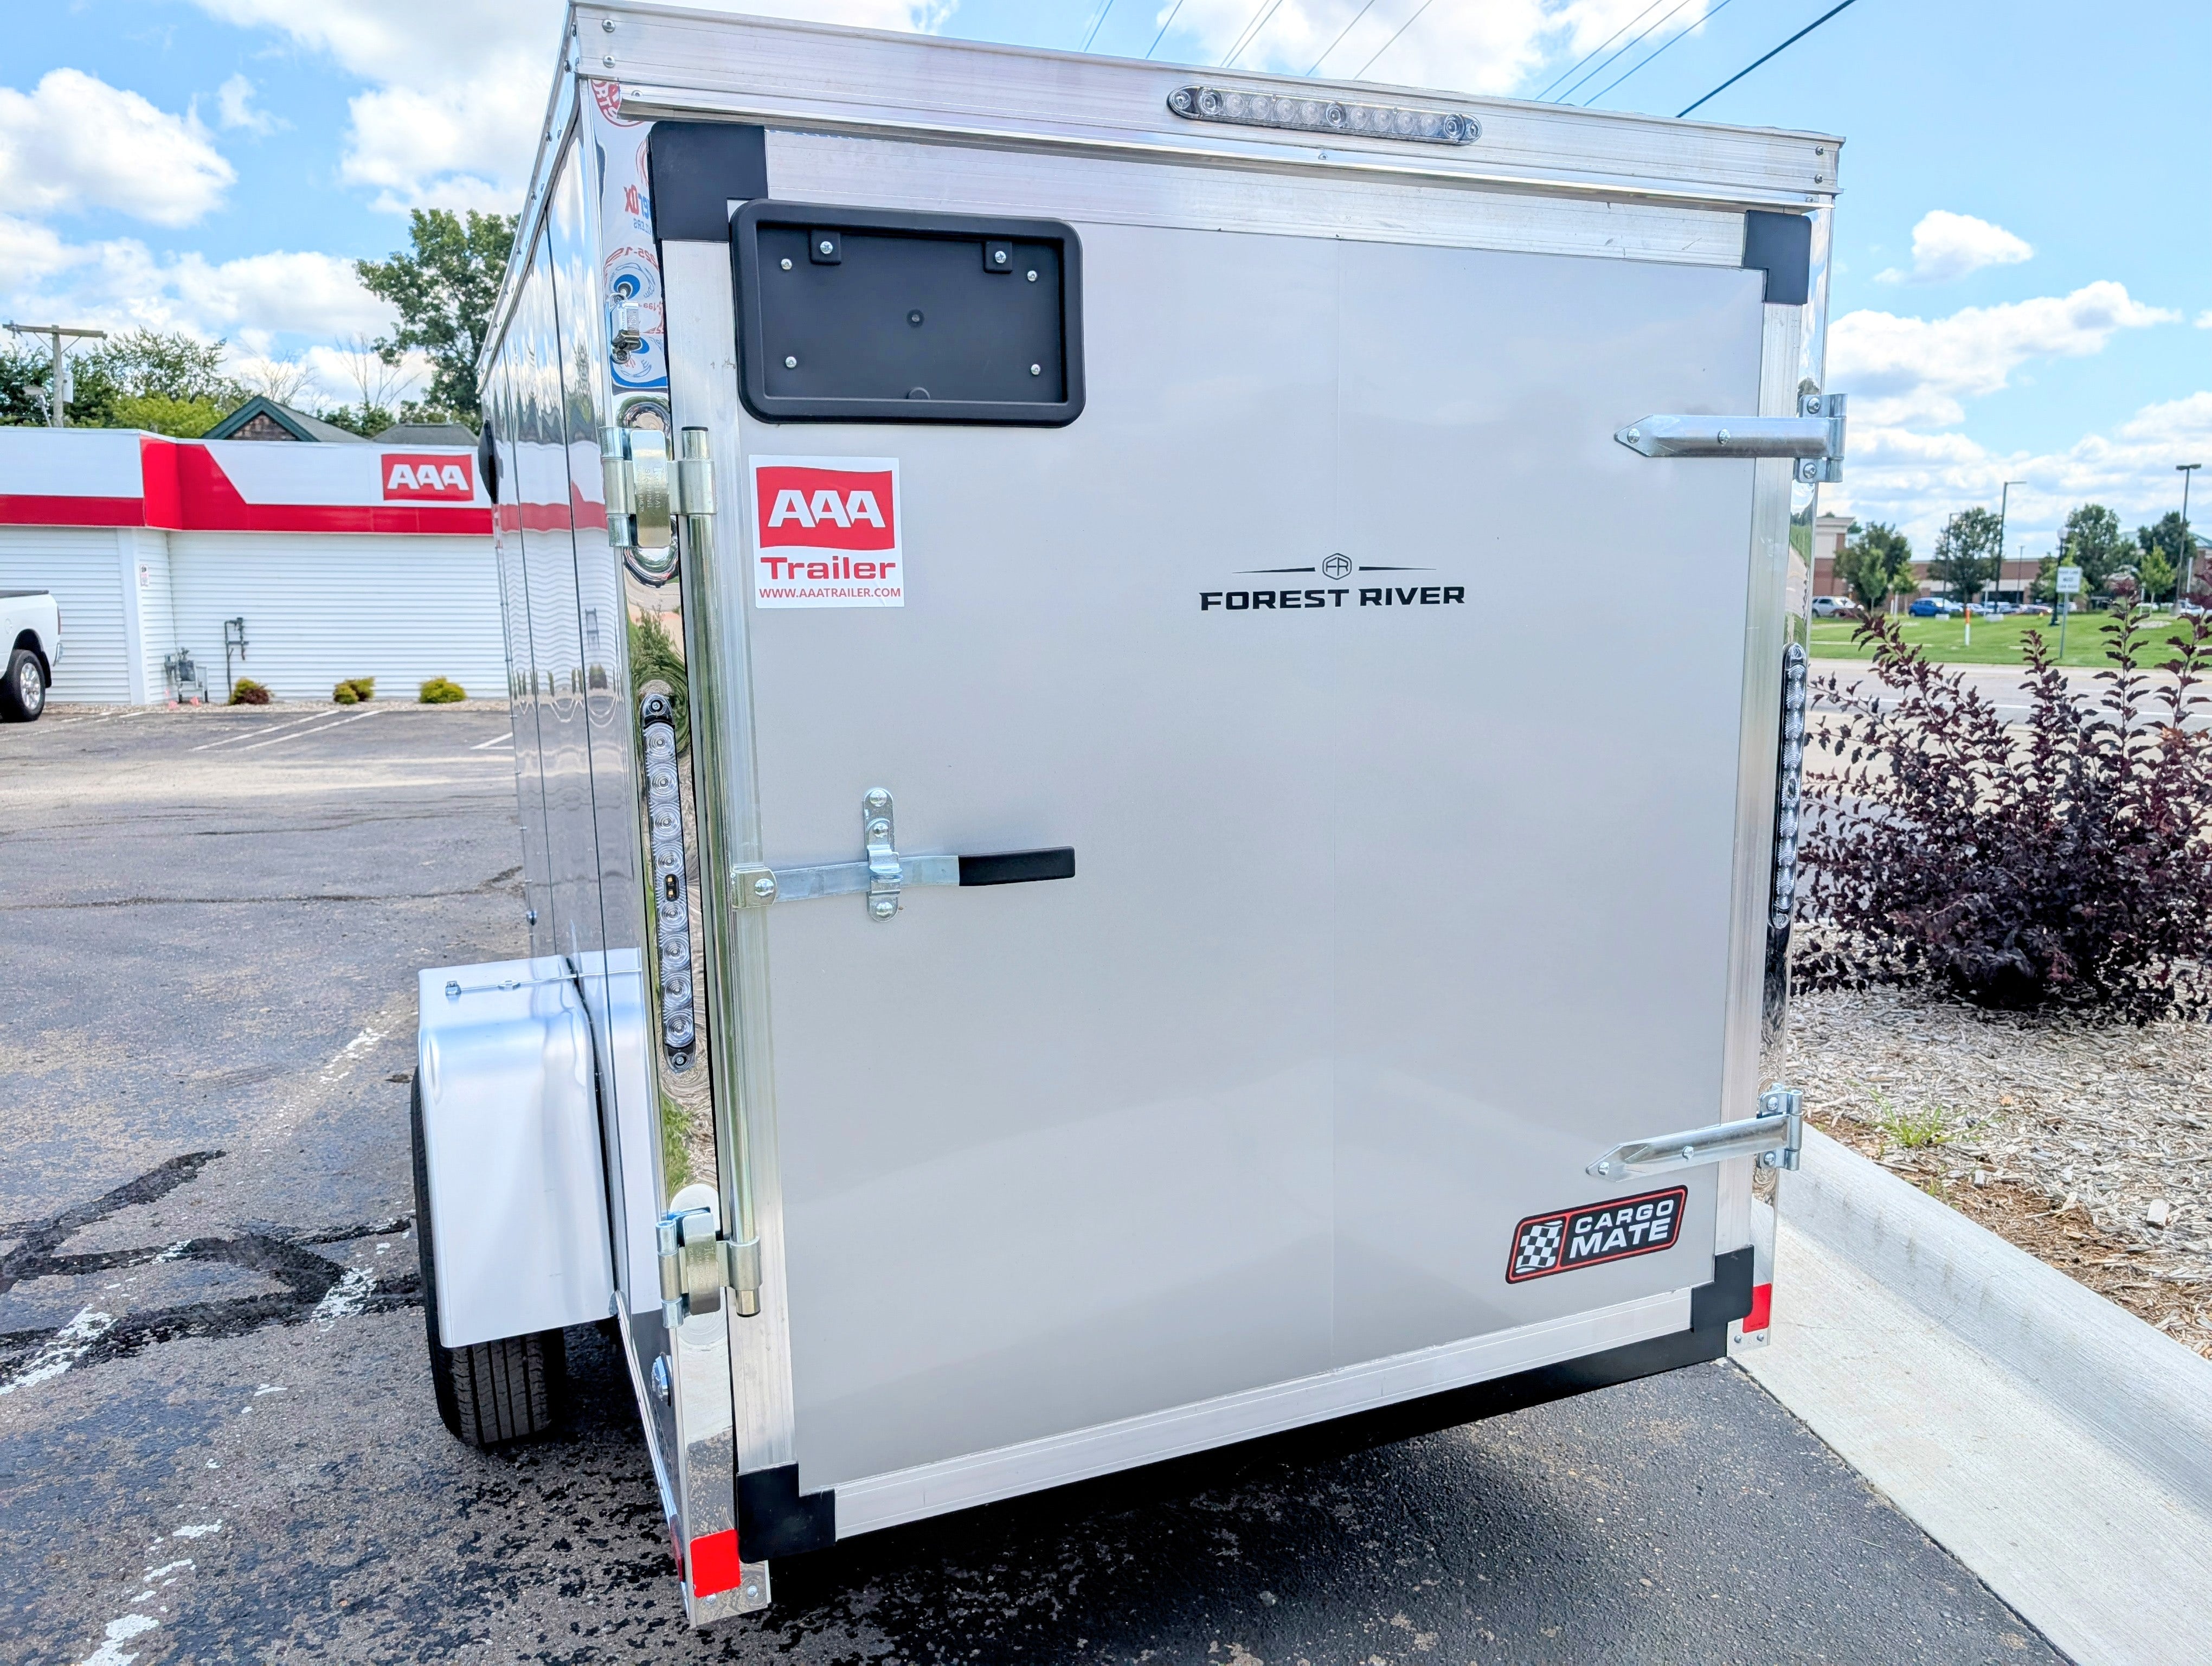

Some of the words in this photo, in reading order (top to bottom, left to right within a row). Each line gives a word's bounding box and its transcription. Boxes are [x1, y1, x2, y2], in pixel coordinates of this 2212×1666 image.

[387, 464, 470, 491] AAA
[768, 489, 886, 528] AAA
[760, 555, 896, 580] Trailer
[758, 587, 901, 598] WWW.AAATRAILER.COM
[1199, 588, 1350, 611] FOREST
[1358, 586, 1465, 606] RIVER
[1574, 1199, 1674, 1234] CARGO
[1569, 1217, 1671, 1259] MATE
